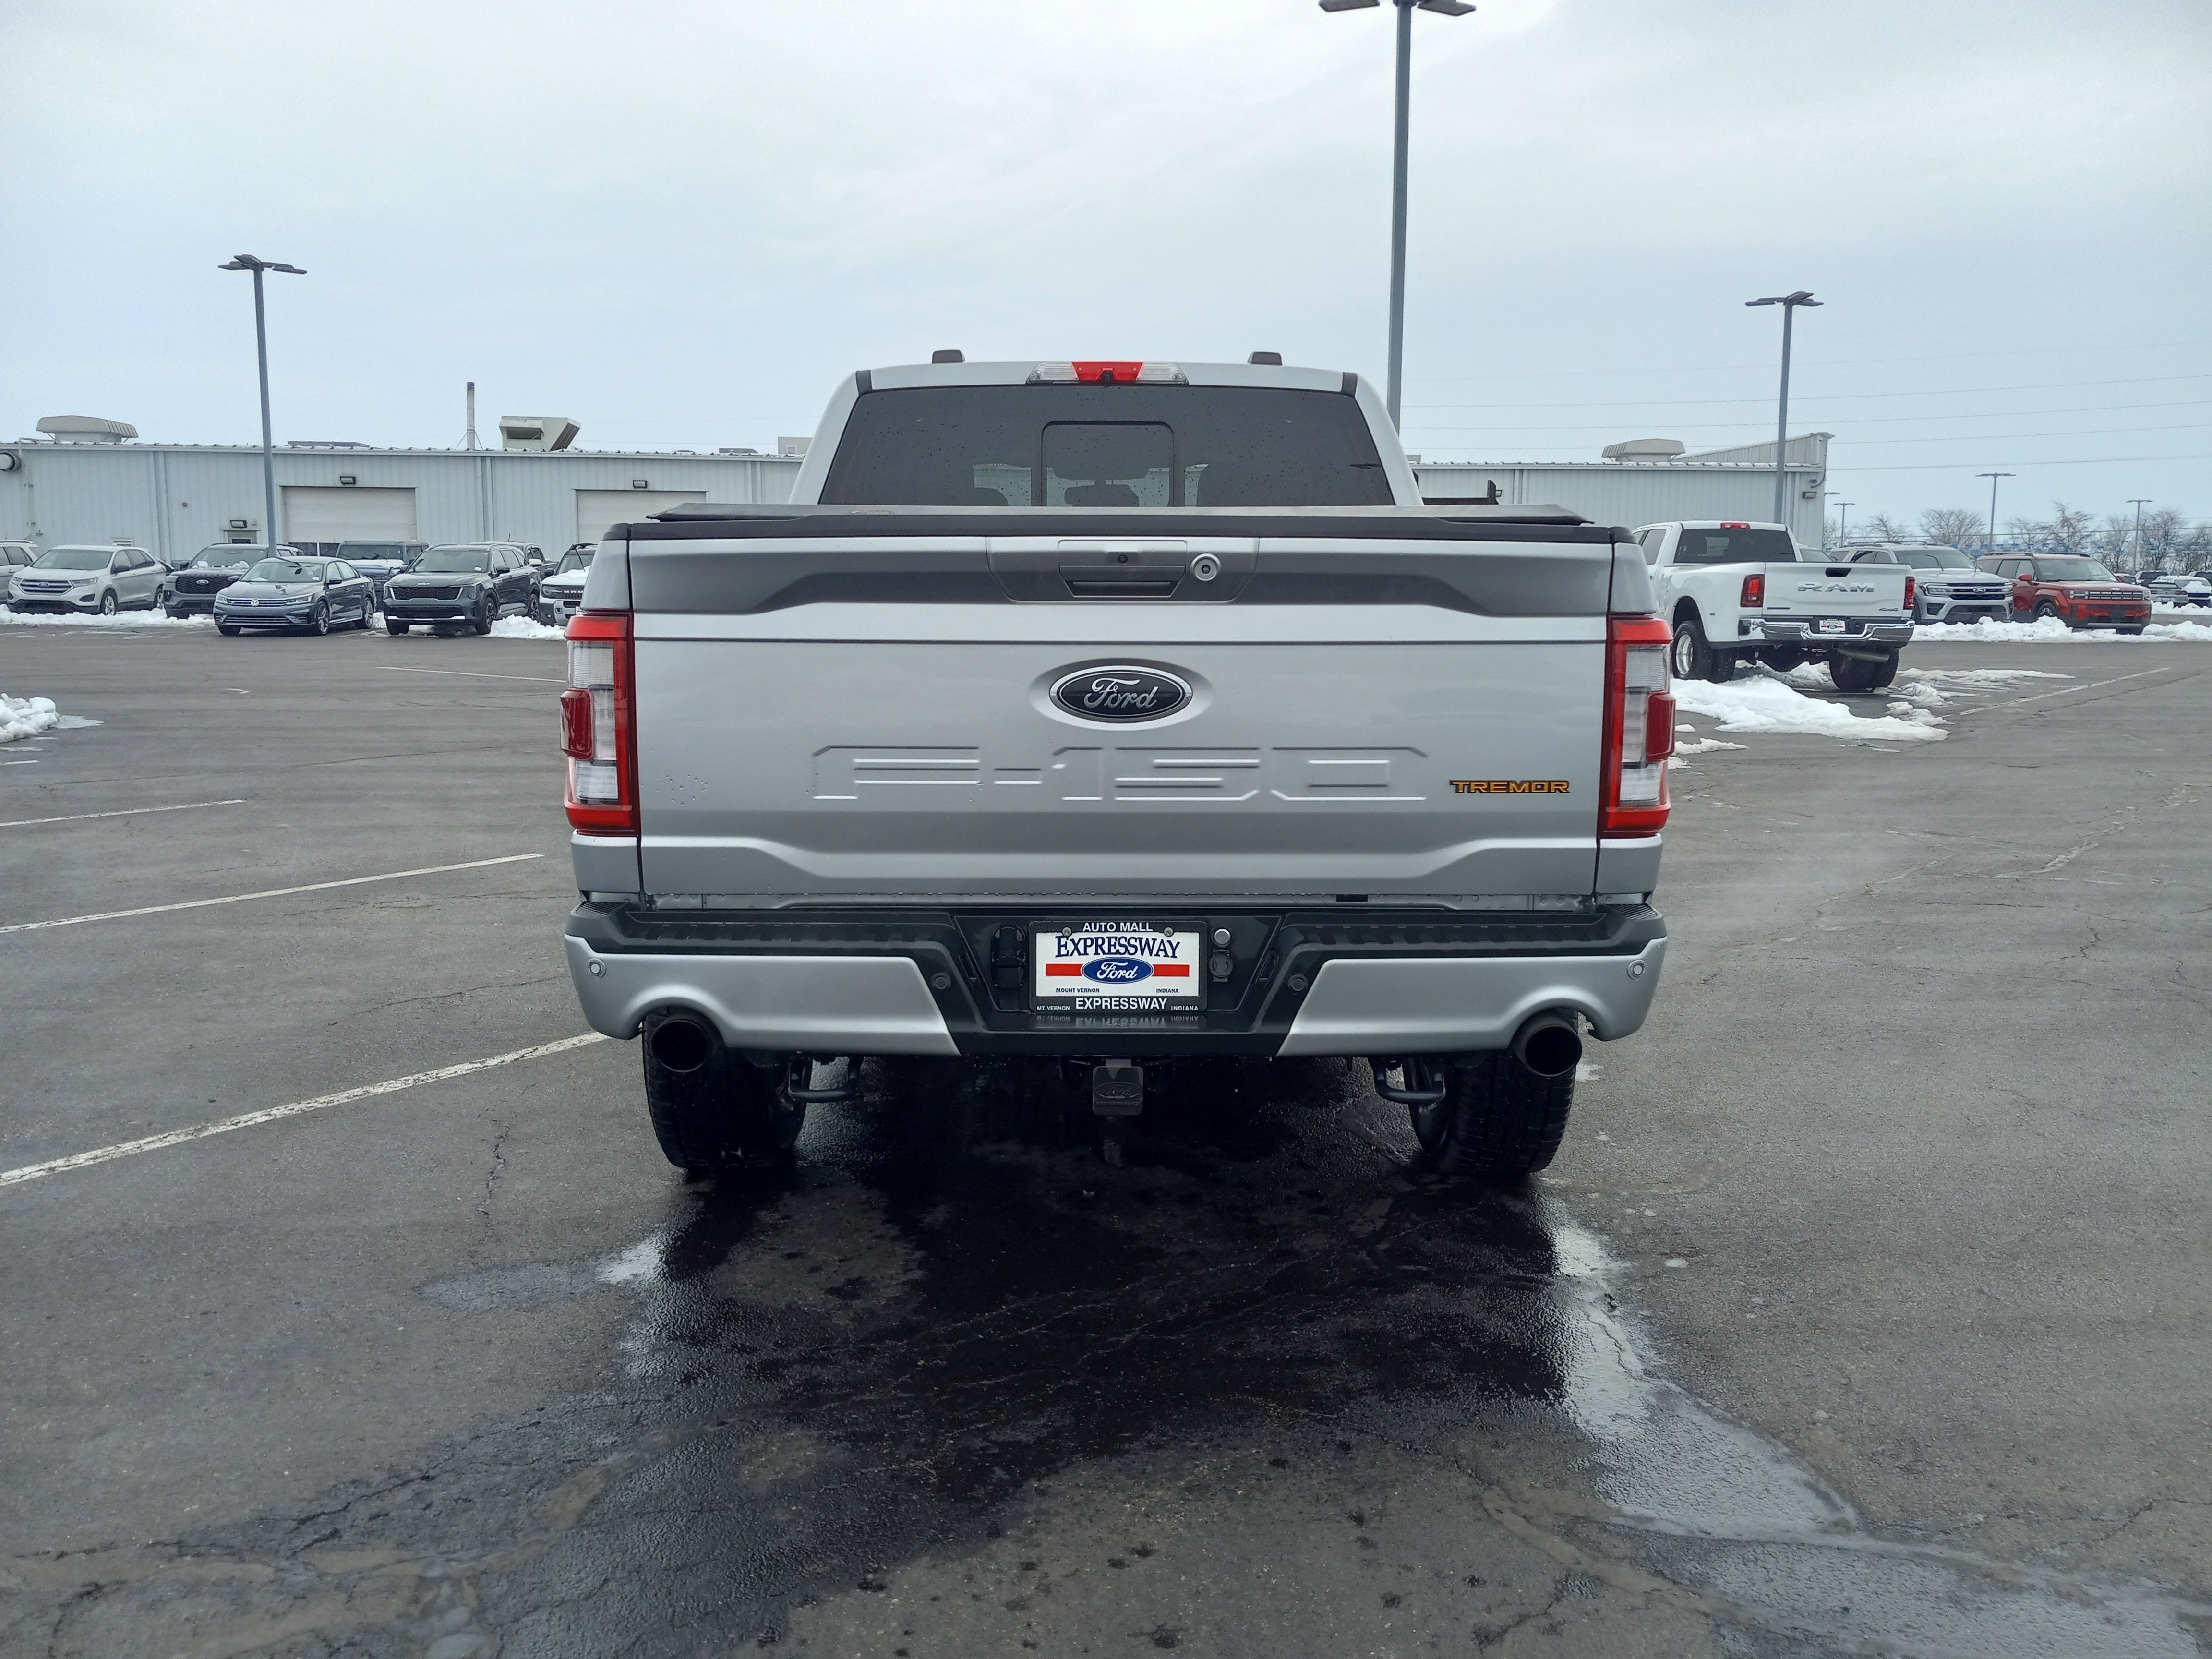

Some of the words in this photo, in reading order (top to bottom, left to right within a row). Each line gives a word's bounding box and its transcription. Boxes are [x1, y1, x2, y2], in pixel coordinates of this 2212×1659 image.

[1798, 581, 1874, 592] RAM
[1083, 677, 1159, 708] Ford
[812, 745, 1428, 801] F-150
[1450, 780, 1571, 793] TREMOR
[1082, 922, 1116, 932] AUTO
[1120, 922, 1153, 932] MALL
[1055, 935, 1181, 958] EXPRESSWAY
[1096, 961, 1139, 979] Ford
[1076, 998, 1167, 1010] EXPRESSWAY
